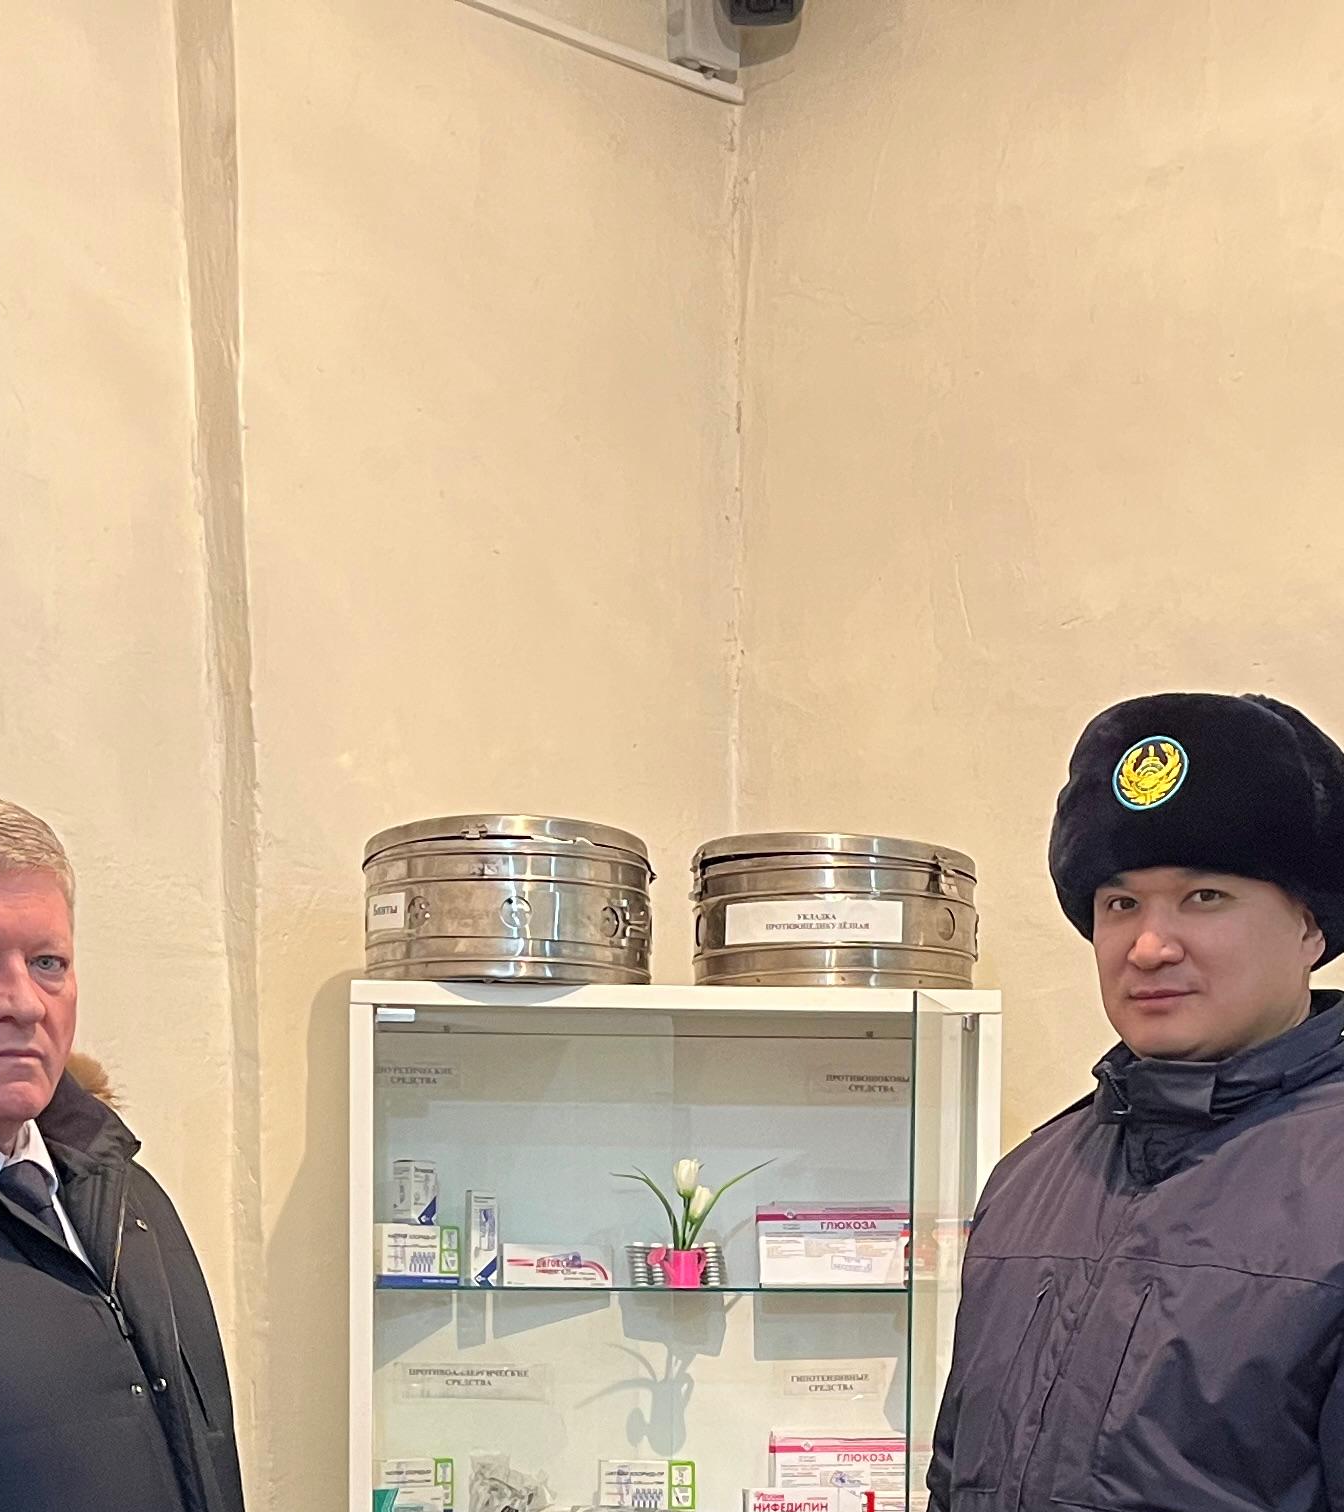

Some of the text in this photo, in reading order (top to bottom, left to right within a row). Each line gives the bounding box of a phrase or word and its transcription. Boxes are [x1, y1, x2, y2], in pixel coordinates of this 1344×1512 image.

[797, 913, 837, 921] УКЛАДКА
[820, 1221, 877, 1230] ГЛЮКОЗА
[808, 1384, 854, 1392] СРЕДСТВА
[837, 1453, 894, 1463] ГЛЮКОЗА
